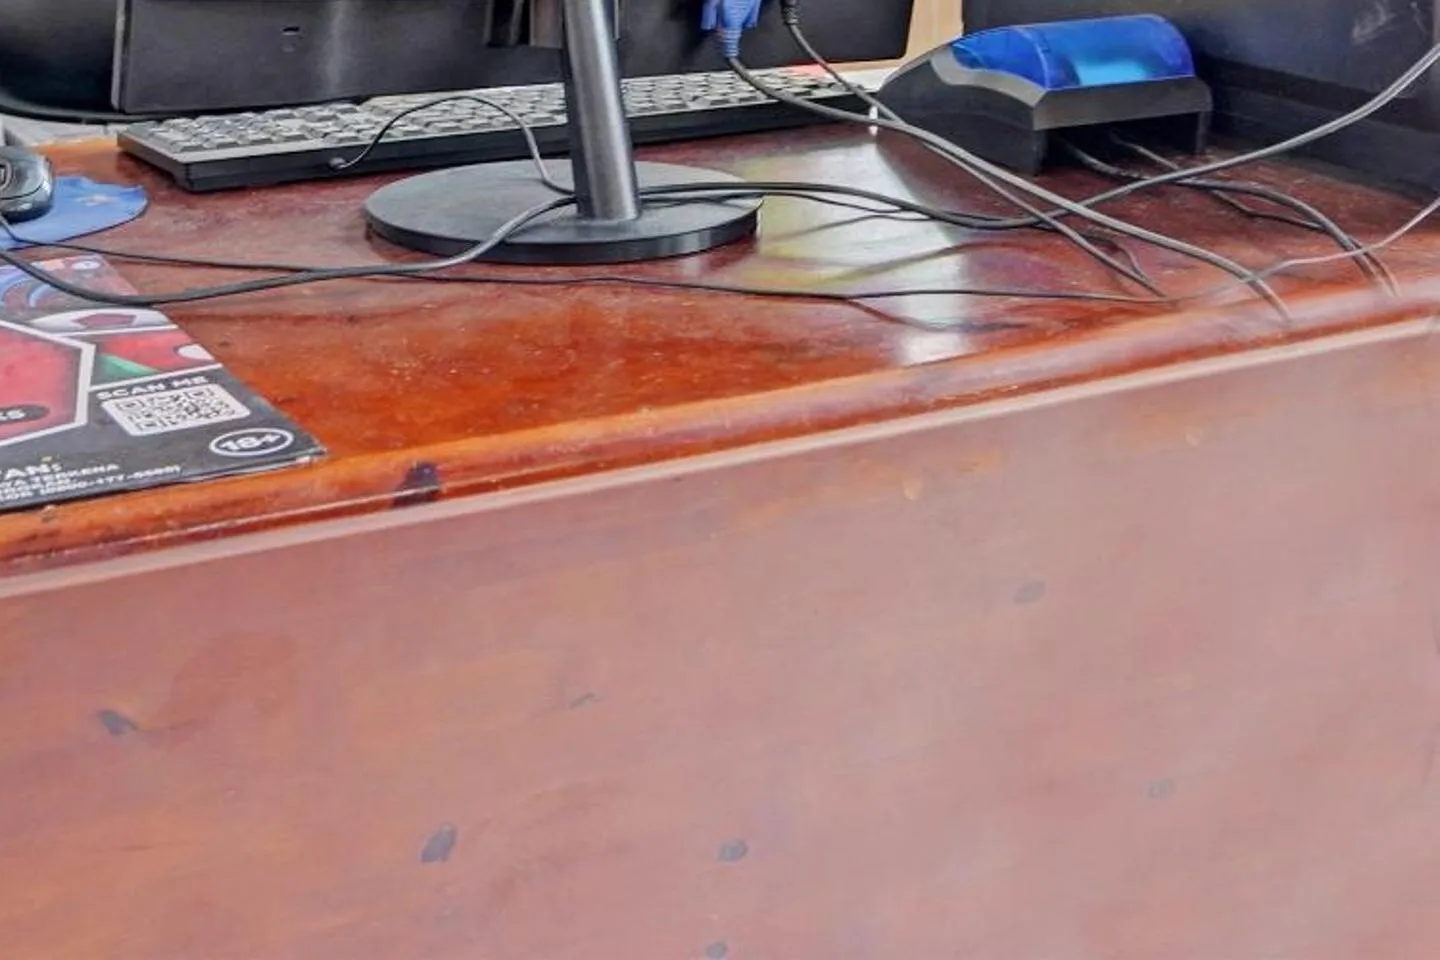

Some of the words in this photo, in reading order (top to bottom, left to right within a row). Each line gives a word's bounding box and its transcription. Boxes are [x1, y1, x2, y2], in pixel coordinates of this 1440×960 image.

[96, 383, 165, 401] SCAN
[172, 375, 209, 389] ME
[220, 433, 282, 452] 18+
